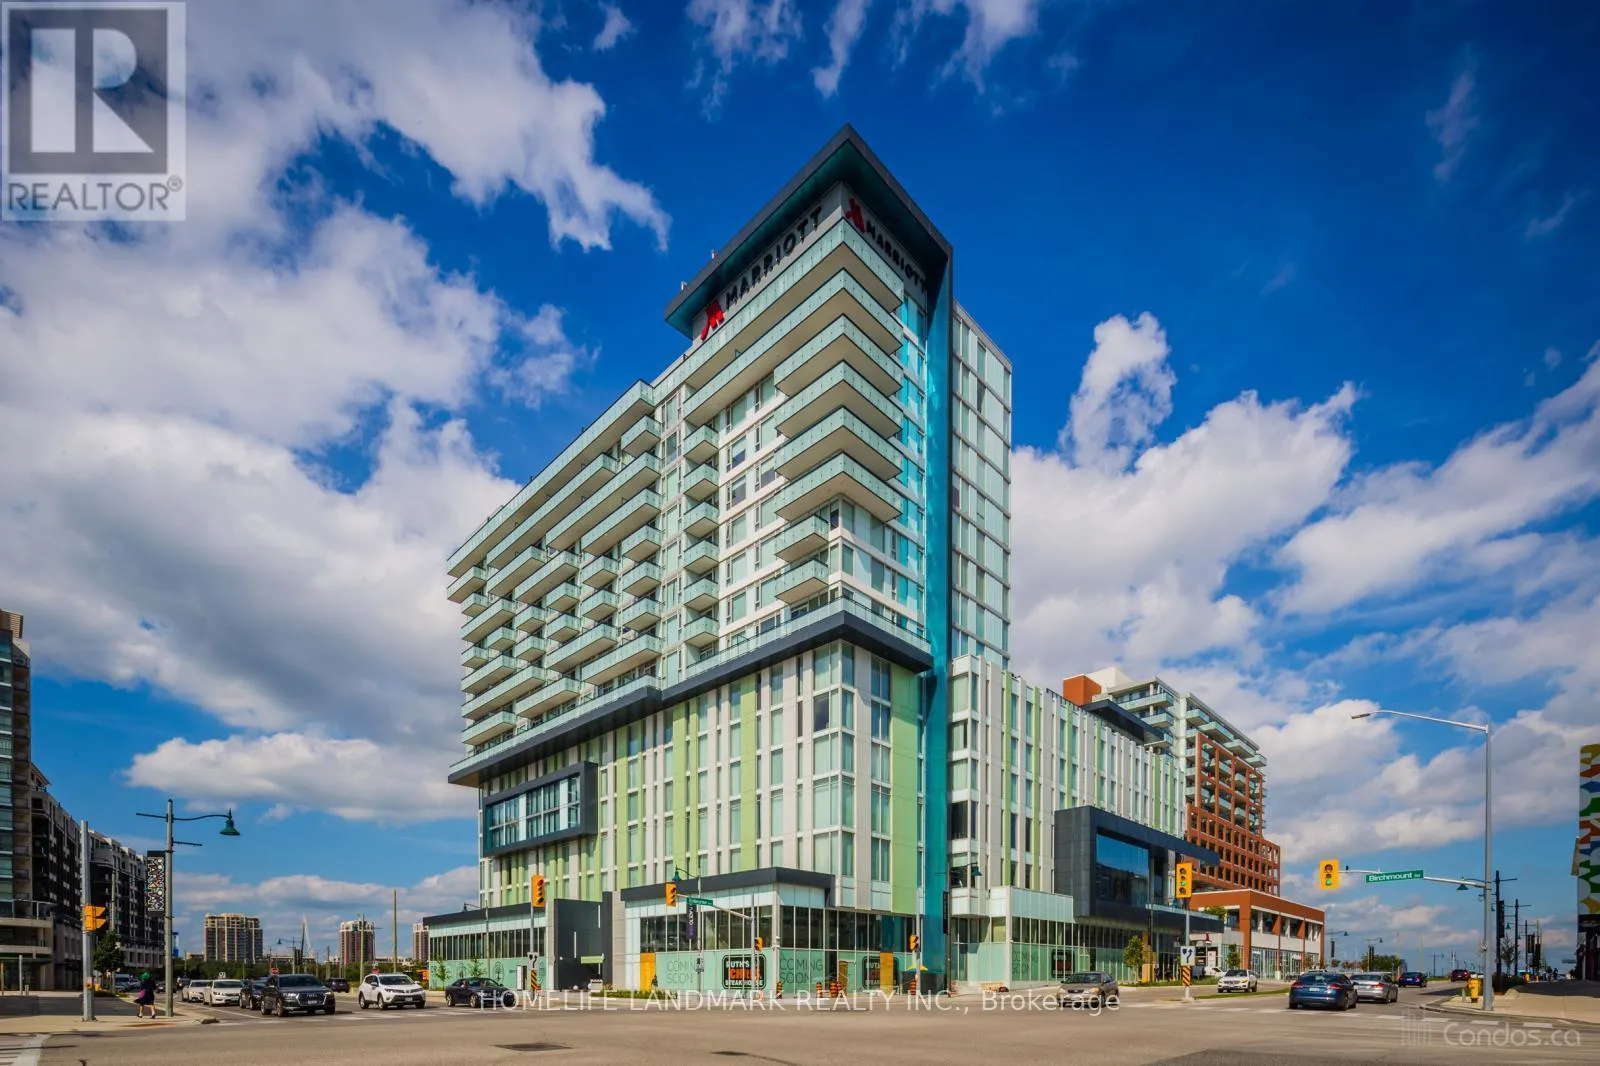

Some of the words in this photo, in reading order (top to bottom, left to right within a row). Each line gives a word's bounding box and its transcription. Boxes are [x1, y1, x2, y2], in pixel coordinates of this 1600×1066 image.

[726, 206, 822, 311] MARRIOTT
[867, 220, 926, 293] MARRIOTT
[1369, 872, 1412, 882] Birchmount
[666, 960, 699, 972] COMIN
[779, 959, 824, 971] COMING
[779, 972, 810, 984] SOON
